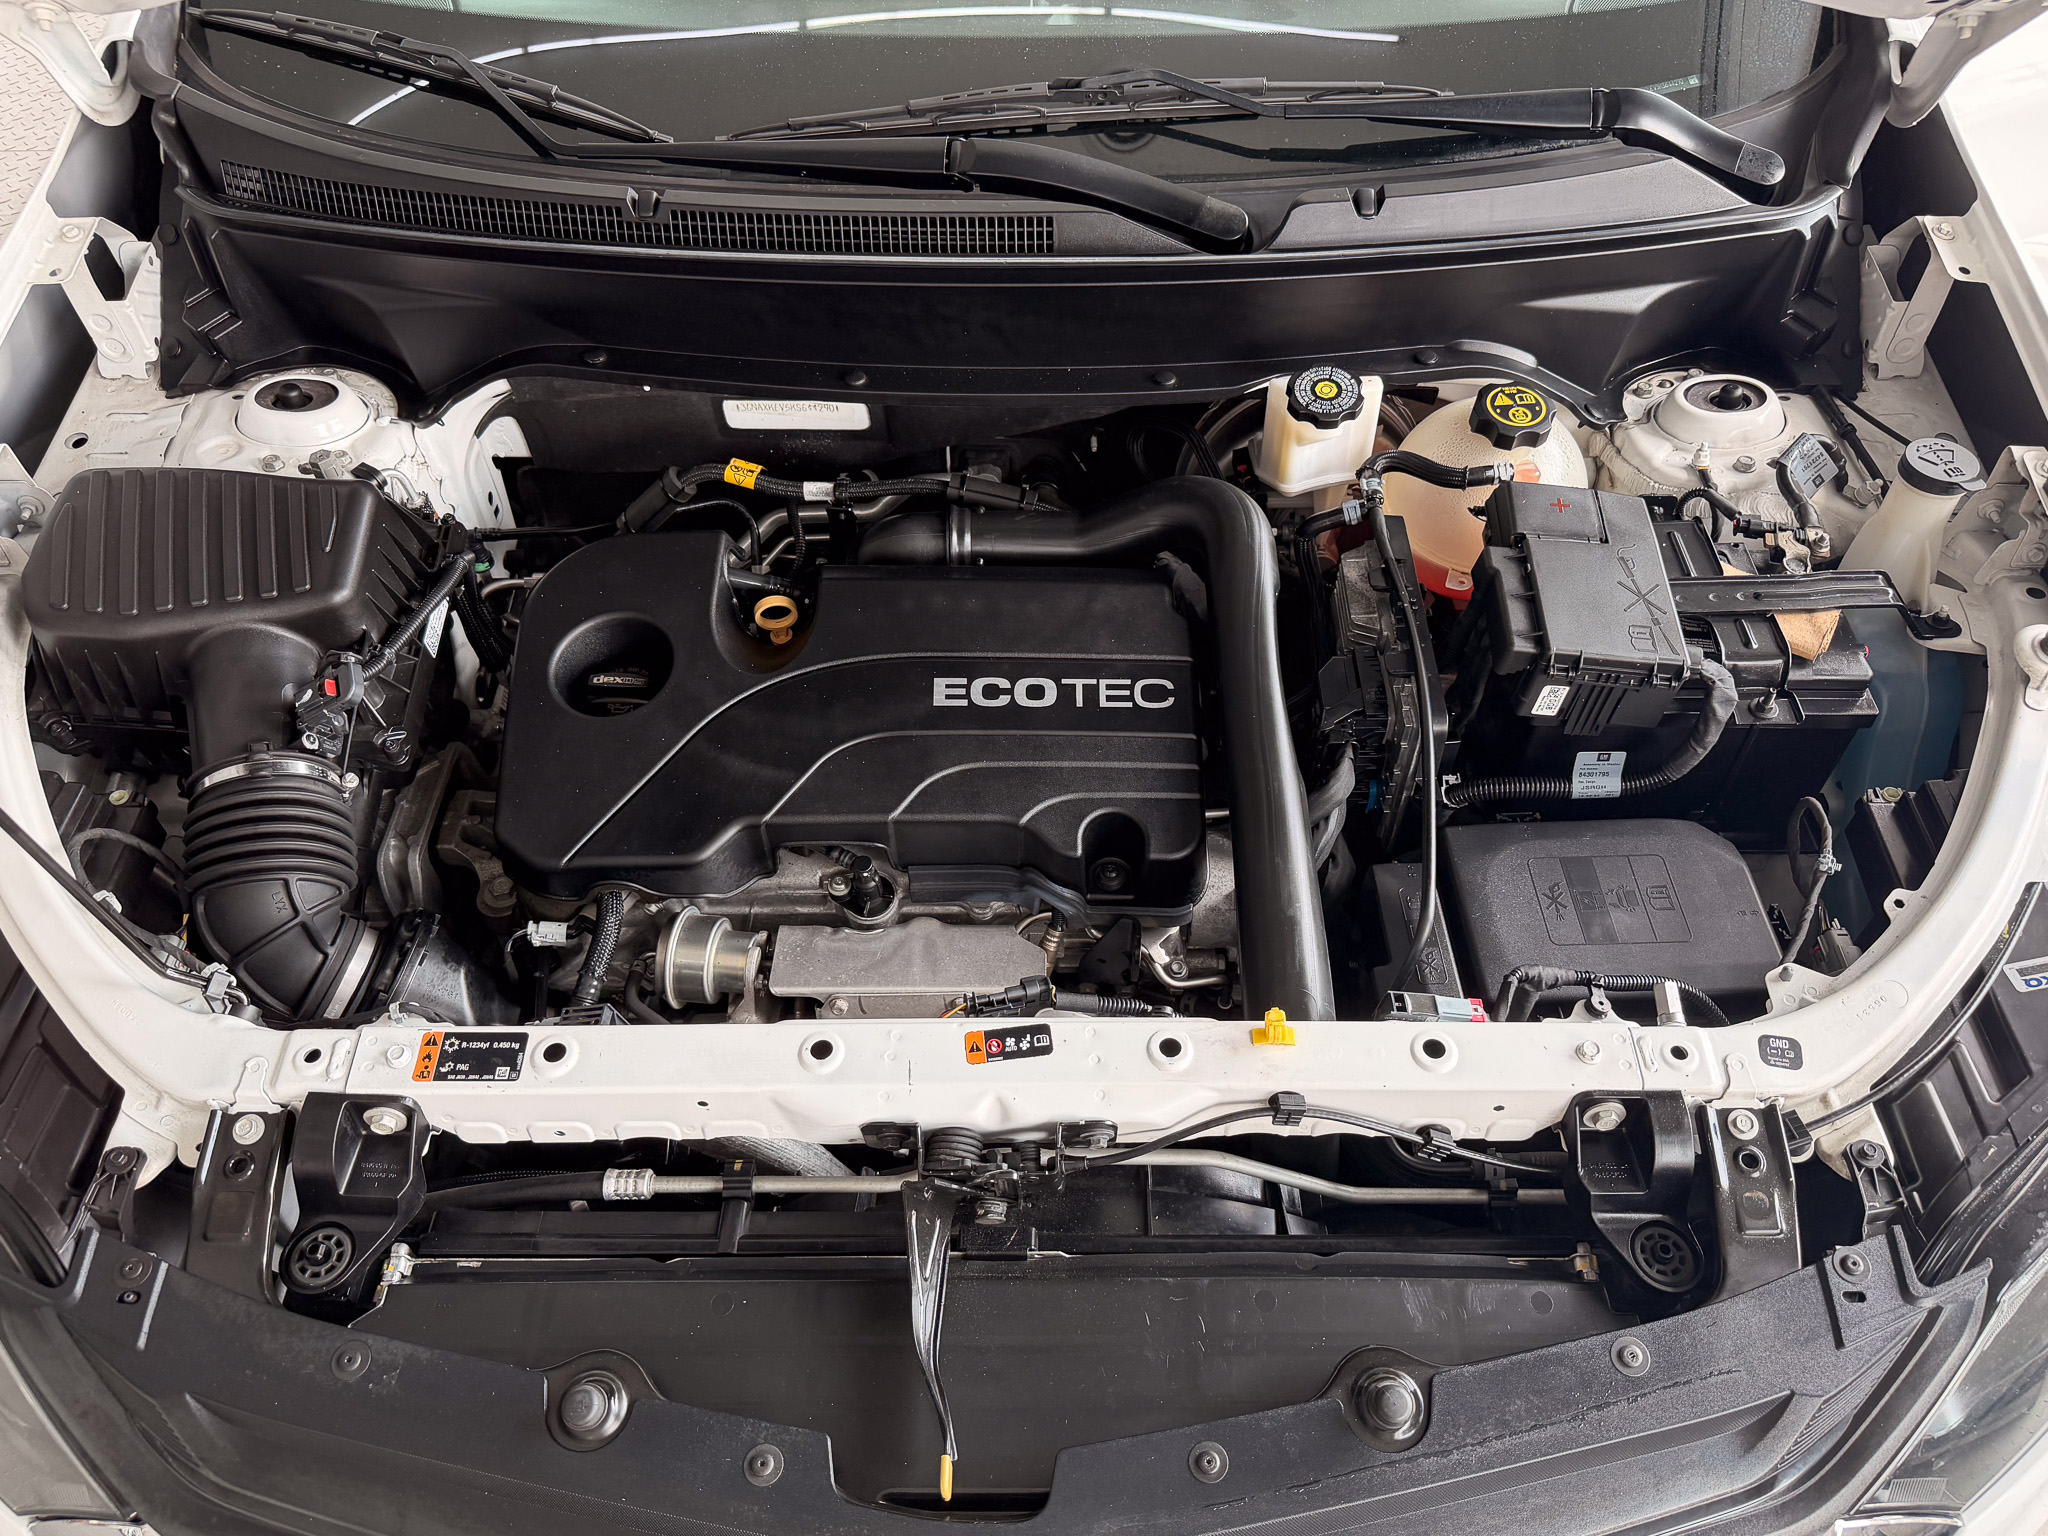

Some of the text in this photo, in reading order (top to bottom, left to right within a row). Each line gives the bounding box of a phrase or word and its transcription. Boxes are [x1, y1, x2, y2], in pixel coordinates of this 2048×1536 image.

[933, 677, 1175, 708] ECOTEC
[461, 1041, 520, 1050] R-1234yf 0.450 kg
[1769, 1037, 1789, 1049] GND
[456, 1063, 470, 1071] PAG
